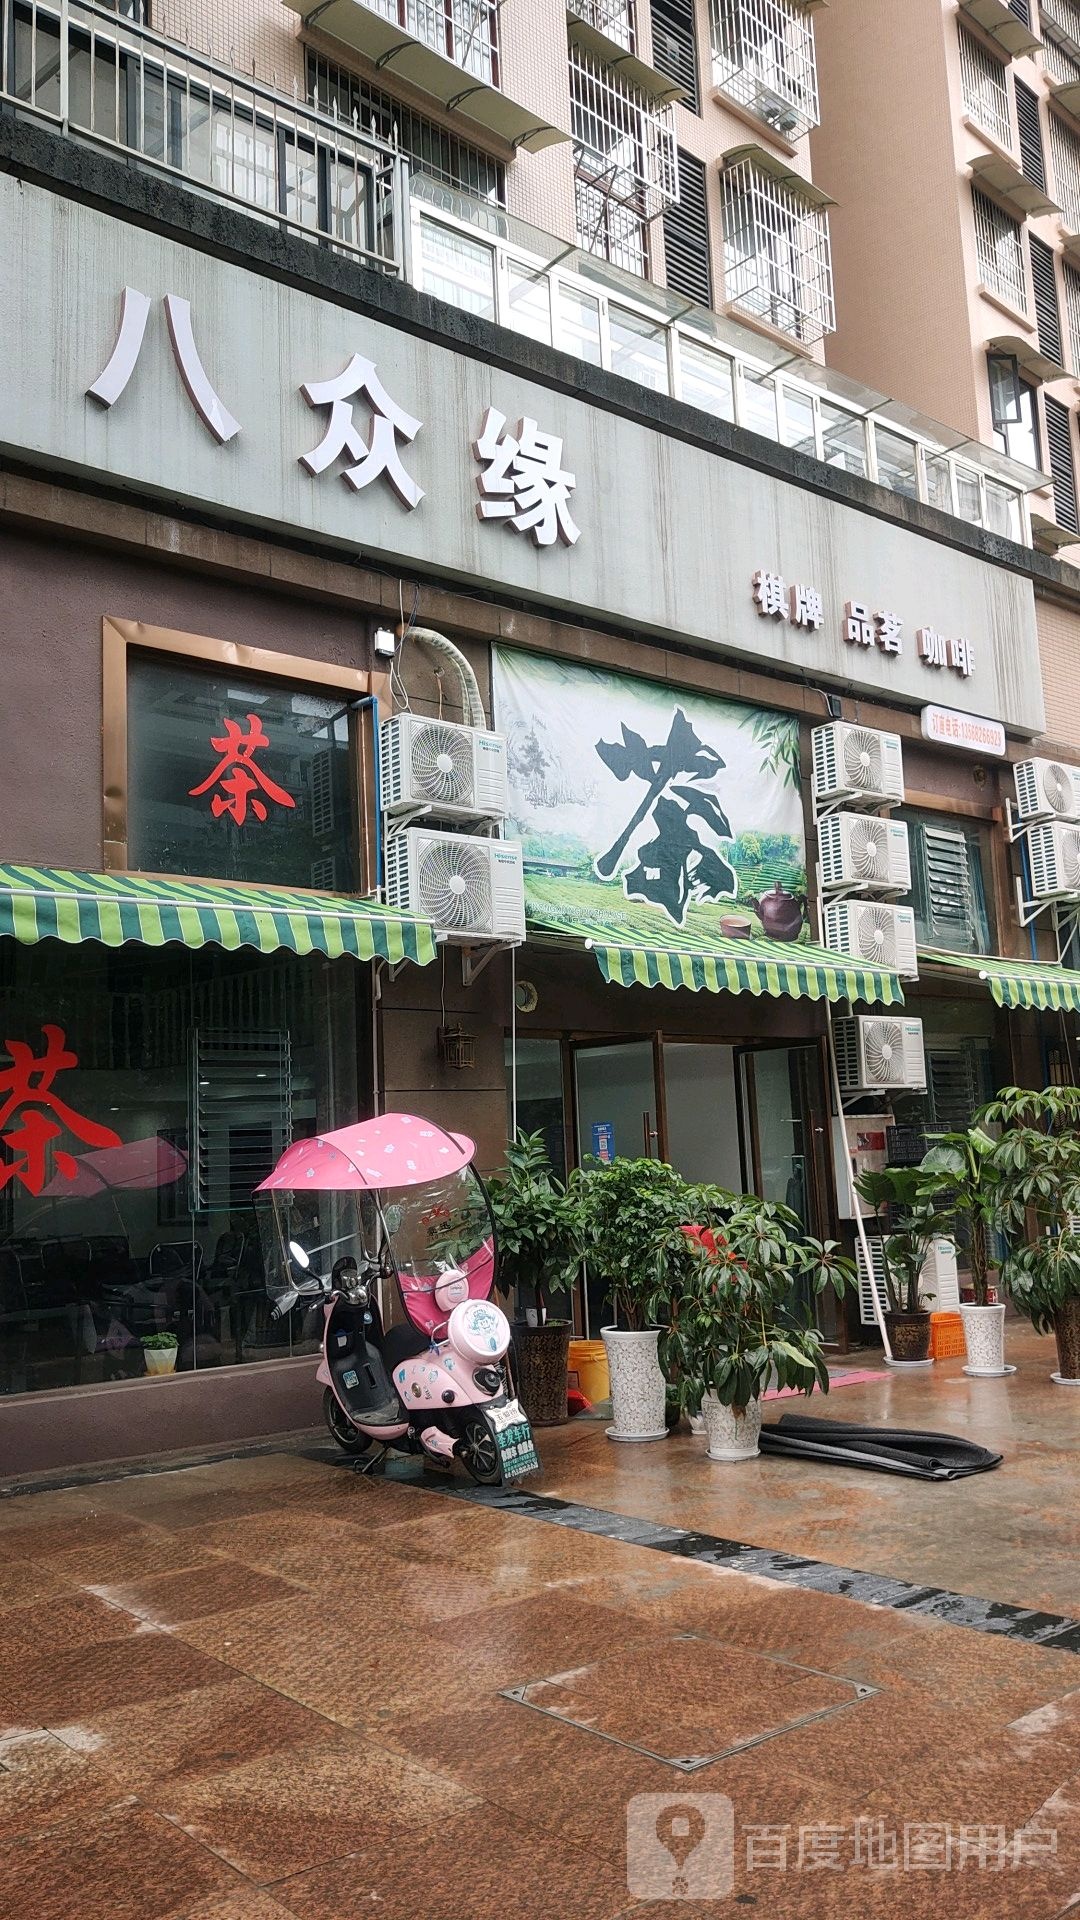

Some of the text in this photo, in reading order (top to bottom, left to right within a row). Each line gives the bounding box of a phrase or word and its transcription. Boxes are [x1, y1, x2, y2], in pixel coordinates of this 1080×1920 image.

[85, 286, 581, 547] 八众缘
[752, 569, 975, 679] 棋牌 品茗 咖啡
[188, 713, 296, 826] 茶
[594, 704, 737, 928] 茶
[0, 1024, 123, 1197] 茶
